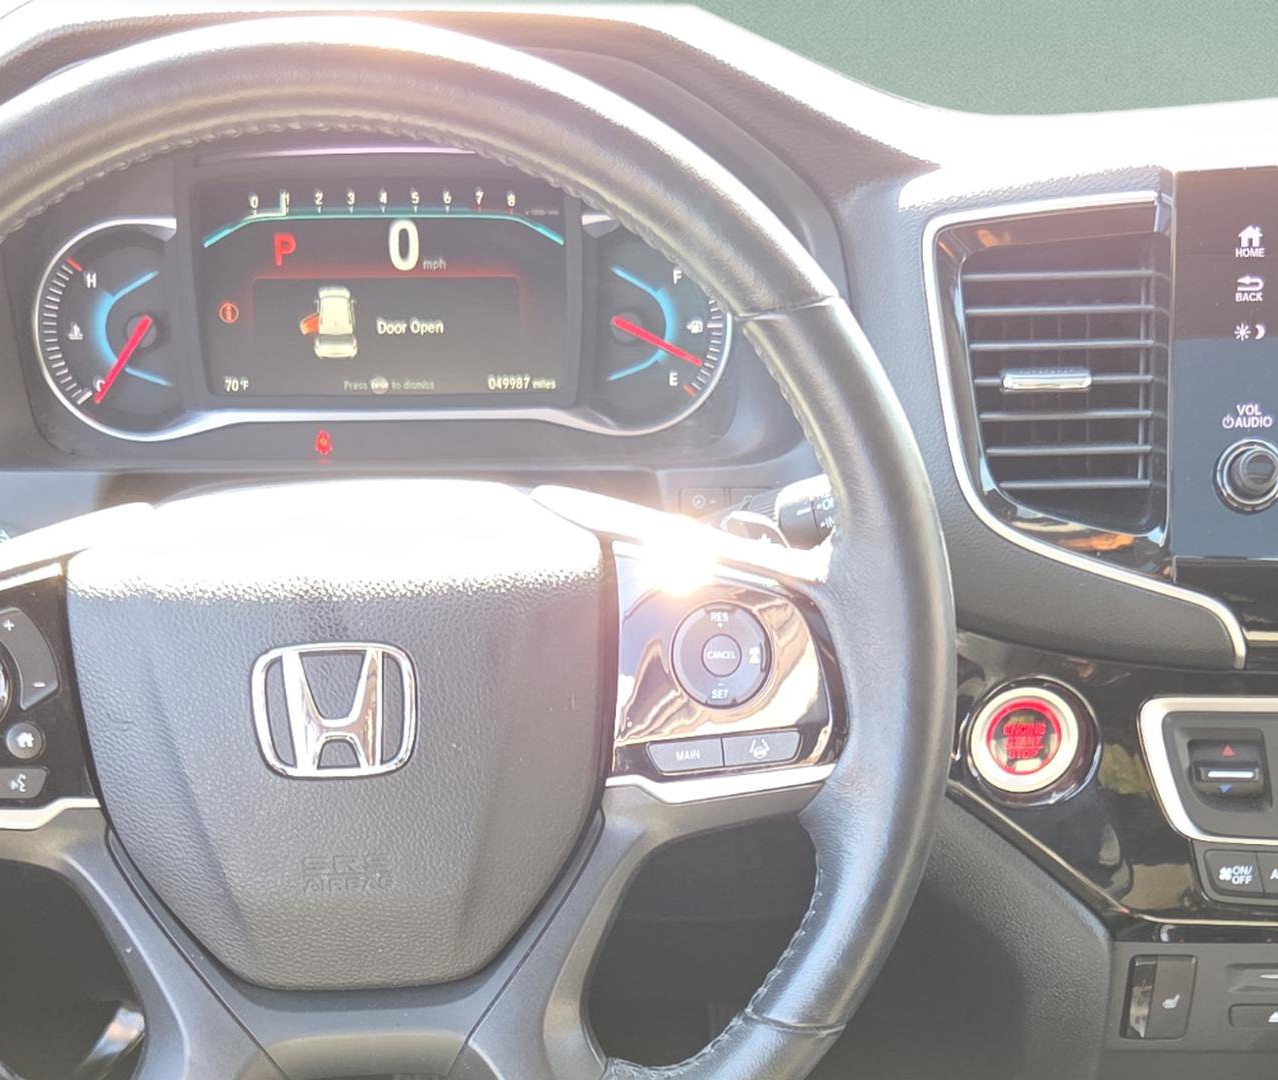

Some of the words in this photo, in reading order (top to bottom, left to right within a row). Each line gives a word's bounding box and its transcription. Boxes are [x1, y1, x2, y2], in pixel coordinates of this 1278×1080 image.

[250, 195, 259, 208] 0
[315, 192, 323, 204] 2
[347, 192, 355, 204] 3
[379, 191, 387, 204] 4
[411, 191, 419, 204] 5
[443, 191, 452, 204] 6
[475, 191, 483, 204] 7
[507, 193, 515, 207] 8
[274, 232, 296, 266] P
[389, 219, 419, 271] 0
[1235, 247, 1265, 258] HOME
[423, 259, 447, 270] mph
[86, 273, 96, 288] H
[673, 270, 682, 284] F
[1235, 292, 1263, 302] BACK
[377, 319, 408, 334] Door
[410, 319, 444, 337] Open
[487, 375, 530, 390] 049987
[533, 378, 556, 389] miles
[669, 372, 678, 386] E
[1237, 404, 1262, 415] VOL
[1235, 416, 1272, 428] AUDIO
[710, 612, 729, 623] RES
[707, 650, 735, 660] CANCEL
[711, 688, 728, 698] SET
[1003, 722, 1046, 736] ENGINE
[676, 750, 700, 761] MAIN
[1232, 875, 1252, 885] OFF
